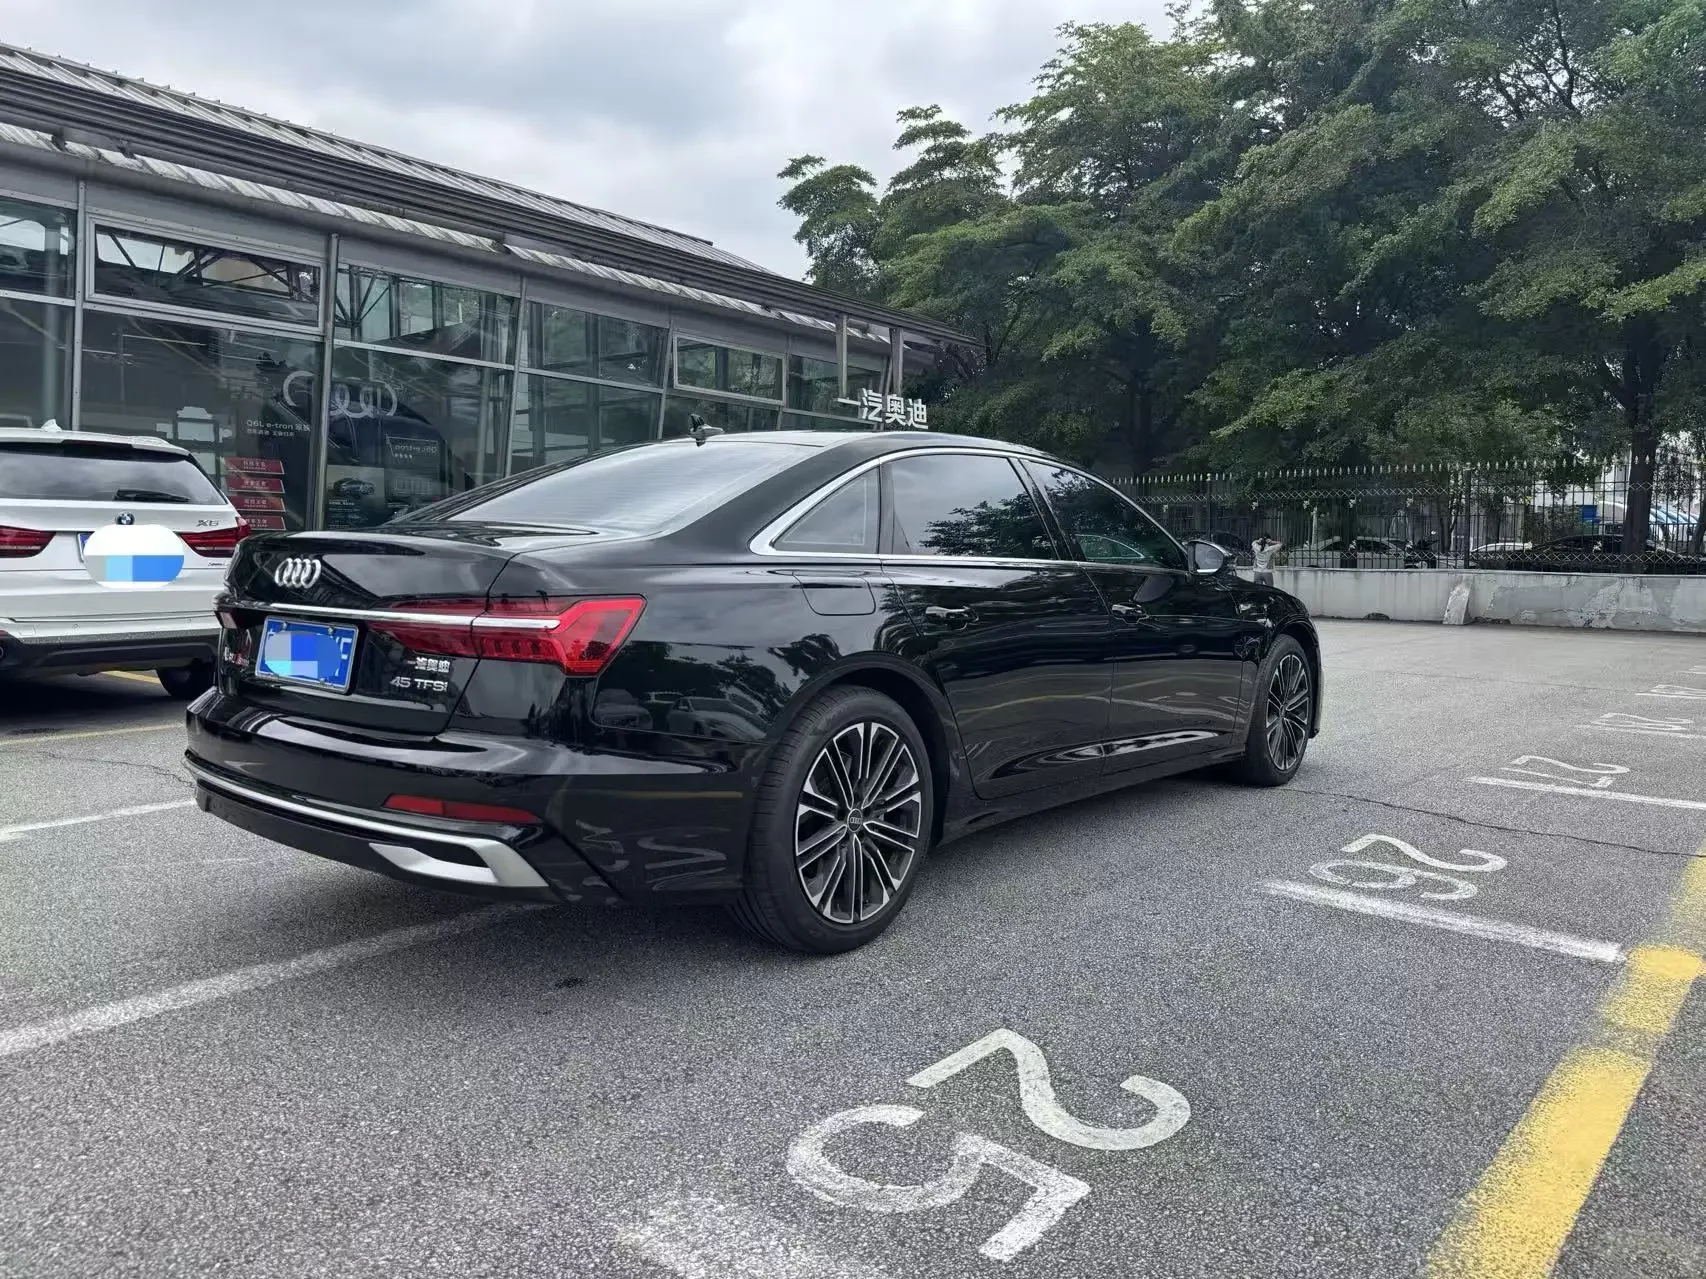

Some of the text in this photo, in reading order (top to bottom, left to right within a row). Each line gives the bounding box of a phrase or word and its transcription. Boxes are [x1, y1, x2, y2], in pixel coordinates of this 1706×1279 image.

[266, 422, 294, 430] e-tron
[837, 388, 929, 430] 一汽奥迪
[390, 676, 448, 692] 45 TFSI
[1309, 834, 1507, 900] 26
[787, 1028, 1191, 1262] 25
